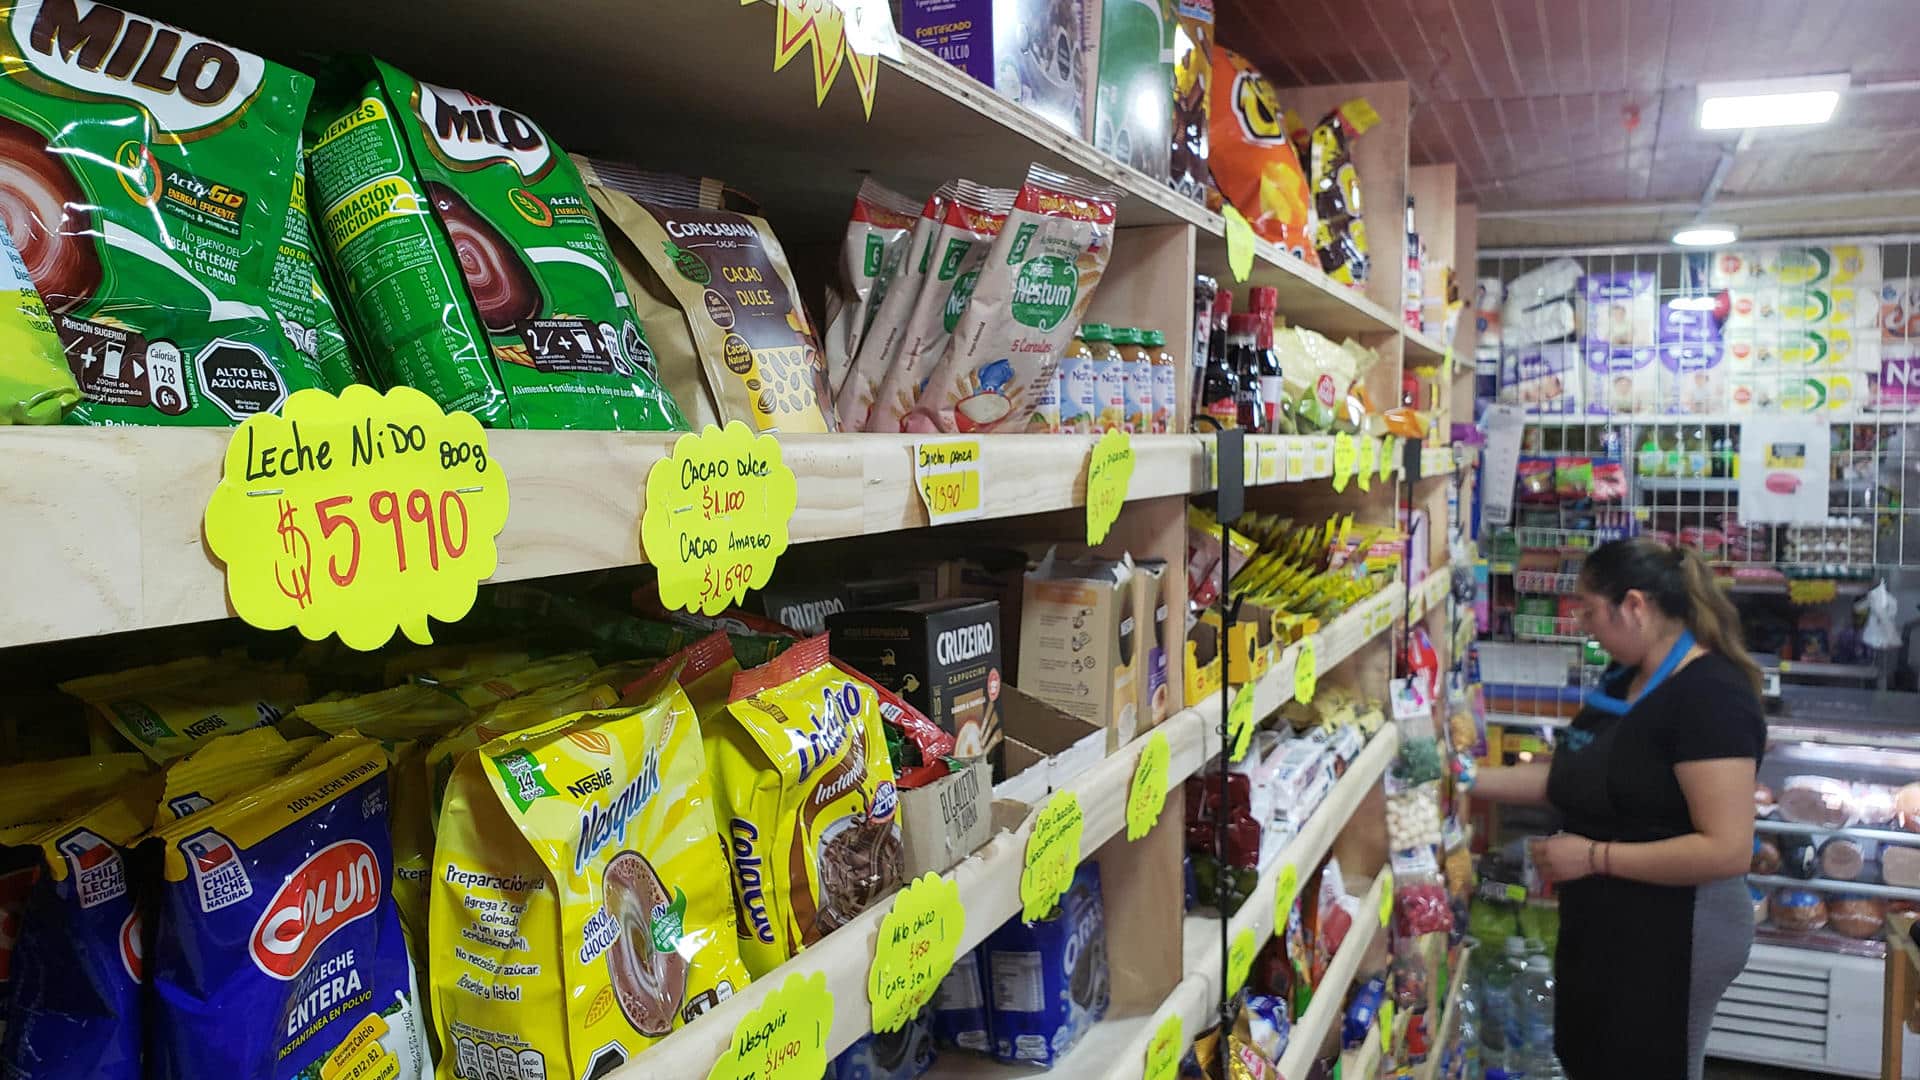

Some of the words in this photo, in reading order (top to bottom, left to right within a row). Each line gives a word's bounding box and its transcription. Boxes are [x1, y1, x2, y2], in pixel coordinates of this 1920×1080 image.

[915, 20, 972, 39] FORTIFICADO
[30, 0, 240, 105] MILO
[938, 44, 970, 60] CALCIO
[328, 182, 399, 233] ORMACIÓN
[666, 220, 760, 239] COPACABANA
[226, 247, 241, 258] DEL
[1016, 236, 1028, 249] 6
[195, 261, 206, 274] EL
[207, 266, 237, 285] CACAO
[209, 253, 239, 272] LECHE
[723, 266, 763, 283] CACAO
[736, 290, 774, 306] DULCE
[1015, 278, 1071, 306] Nestum
[727, 344, 747, 356] Cacao
[153, 364, 176, 385] 128
[216, 367, 248, 378] ALTO
[251, 369, 268, 379] EN
[211, 377, 278, 392] AZÚCARES
[439, 441, 487, 472] 800g
[681, 459, 729, 490] CACAO
[275, 489, 468, 609] $5990
[680, 532, 717, 563] CACAO
[937, 622, 993, 666] CRUZEIRO
[948, 666, 987, 686] CAPPUCCINO
[287, 796, 317, 813] 100%
[315, 780, 345, 799] LECHE
[341, 760, 379, 784] NATURAL
[518, 773, 534, 793] 14
[567, 768, 613, 799] Nestlé
[575, 745, 660, 876] Nesquik
[81, 862, 122, 883] CHILE
[203, 865, 241, 890] CHILE
[83, 877, 124, 894] LECHE
[84, 886, 125, 904] NATURAL
[205, 878, 246, 900] LECHE
[206, 888, 249, 909] NATURAL
[465, 896, 497, 910] Agrega
[501, 902, 507, 911] 2
[479, 925, 490, 934] un
[583, 907, 610, 941] SABOR
[580, 917, 622, 964] CHOCOLATE
[456, 948, 466, 959] No
[504, 964, 538, 976] azúcar.
[288, 969, 362, 1037] ENTERA
[493, 985, 520, 1000] listo!
[279, 1016, 328, 1060] INSTANTÁNEA
[329, 1009, 340, 1022] EN
[342, 990, 372, 1012] POLVO
[354, 1024, 374, 1047] Calcio
[353, 1062, 367, 1078] B12
[368, 1048, 379, 1062] B2
[522, 1058, 539, 1066] Sodio
